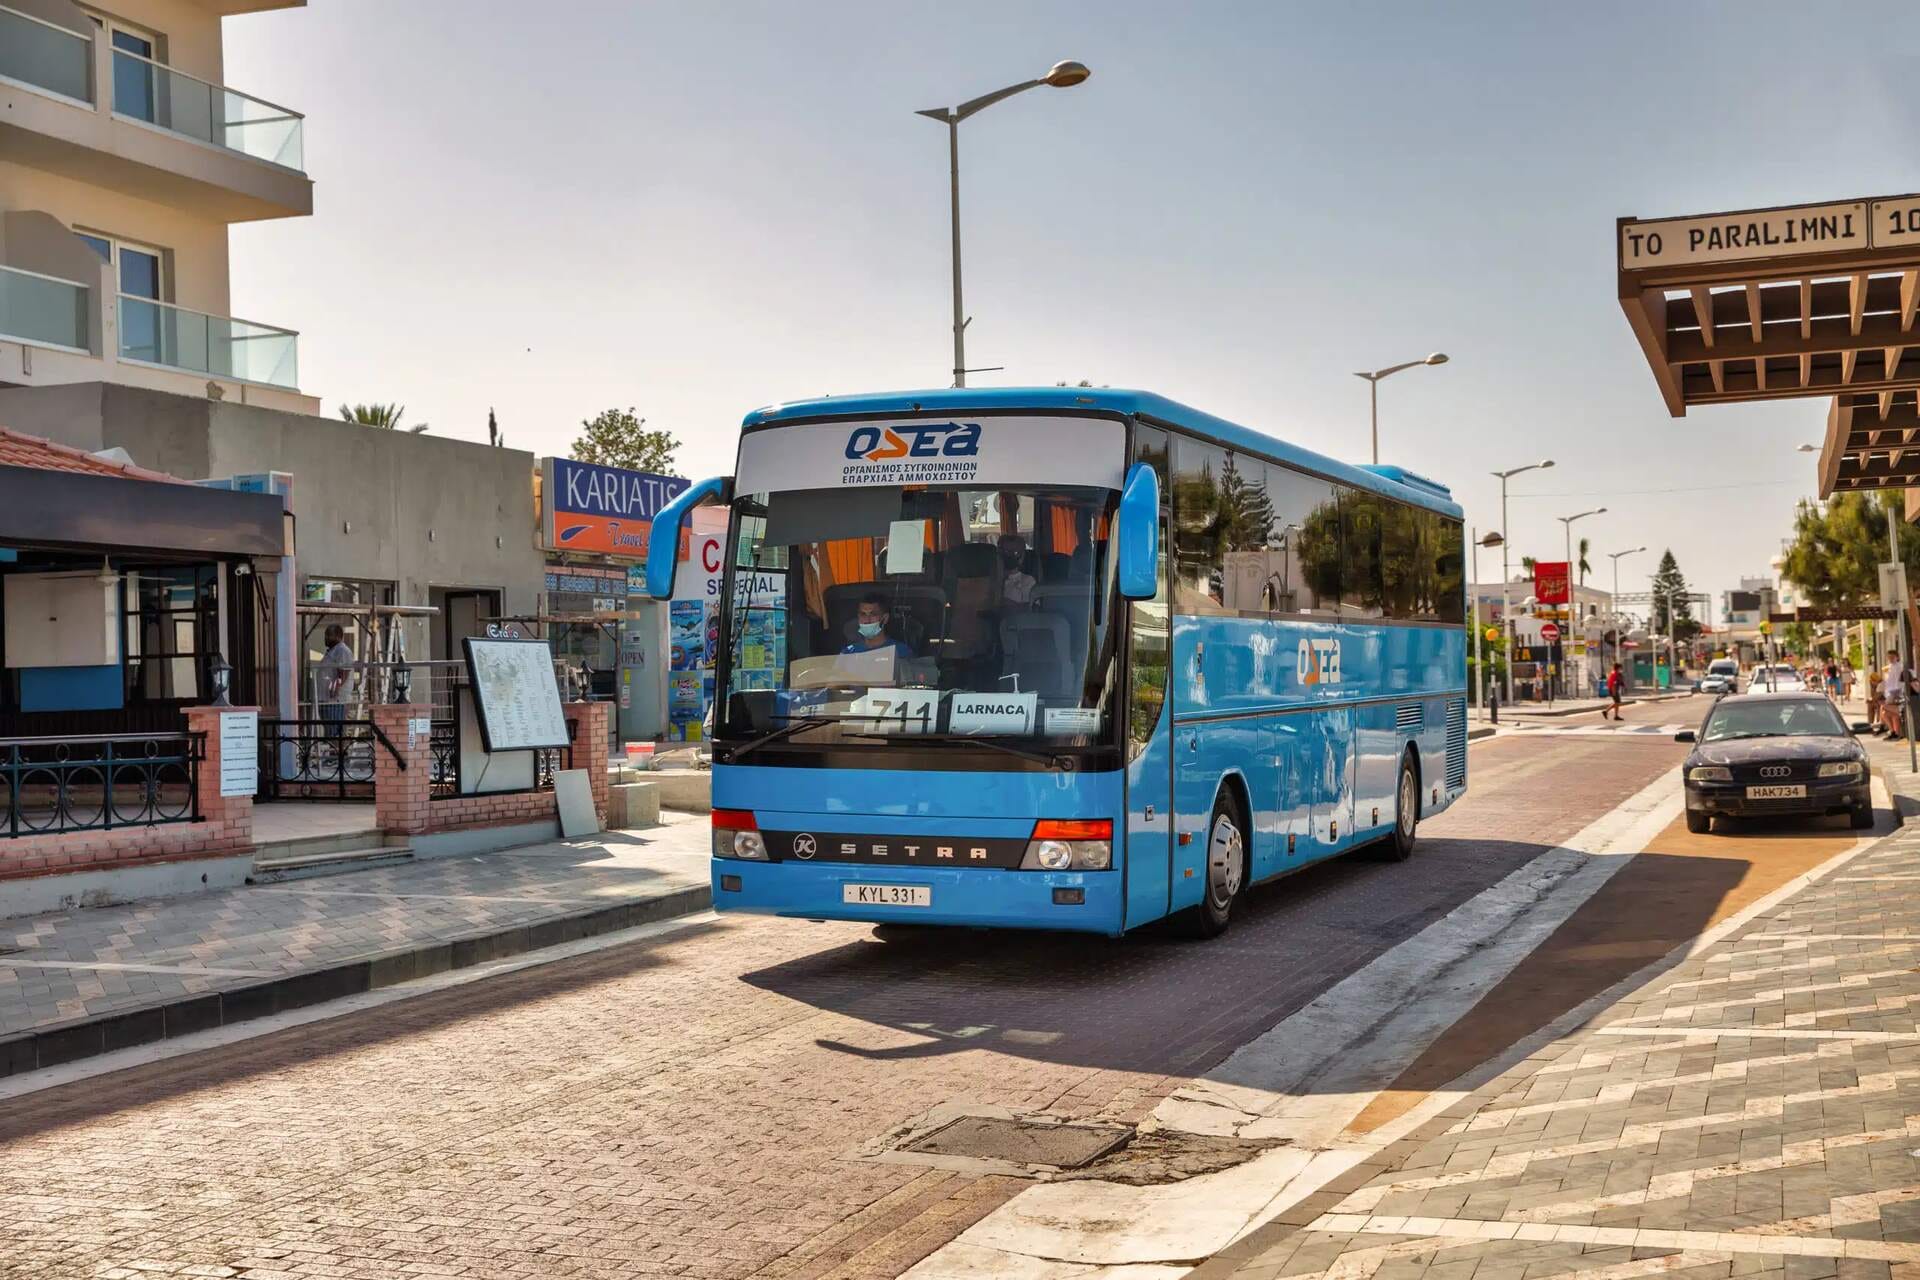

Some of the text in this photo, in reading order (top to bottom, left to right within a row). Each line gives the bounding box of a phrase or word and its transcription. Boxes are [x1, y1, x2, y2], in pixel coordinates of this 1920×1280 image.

[1628, 214, 1856, 257] TO PARALIMNI
[608, 521, 643, 548] Travel
[622, 650, 645, 664] OPEN
[872, 700, 930, 734] 711
[956, 704, 1025, 715] LARNACA
[841, 843, 987, 859] SETRA
